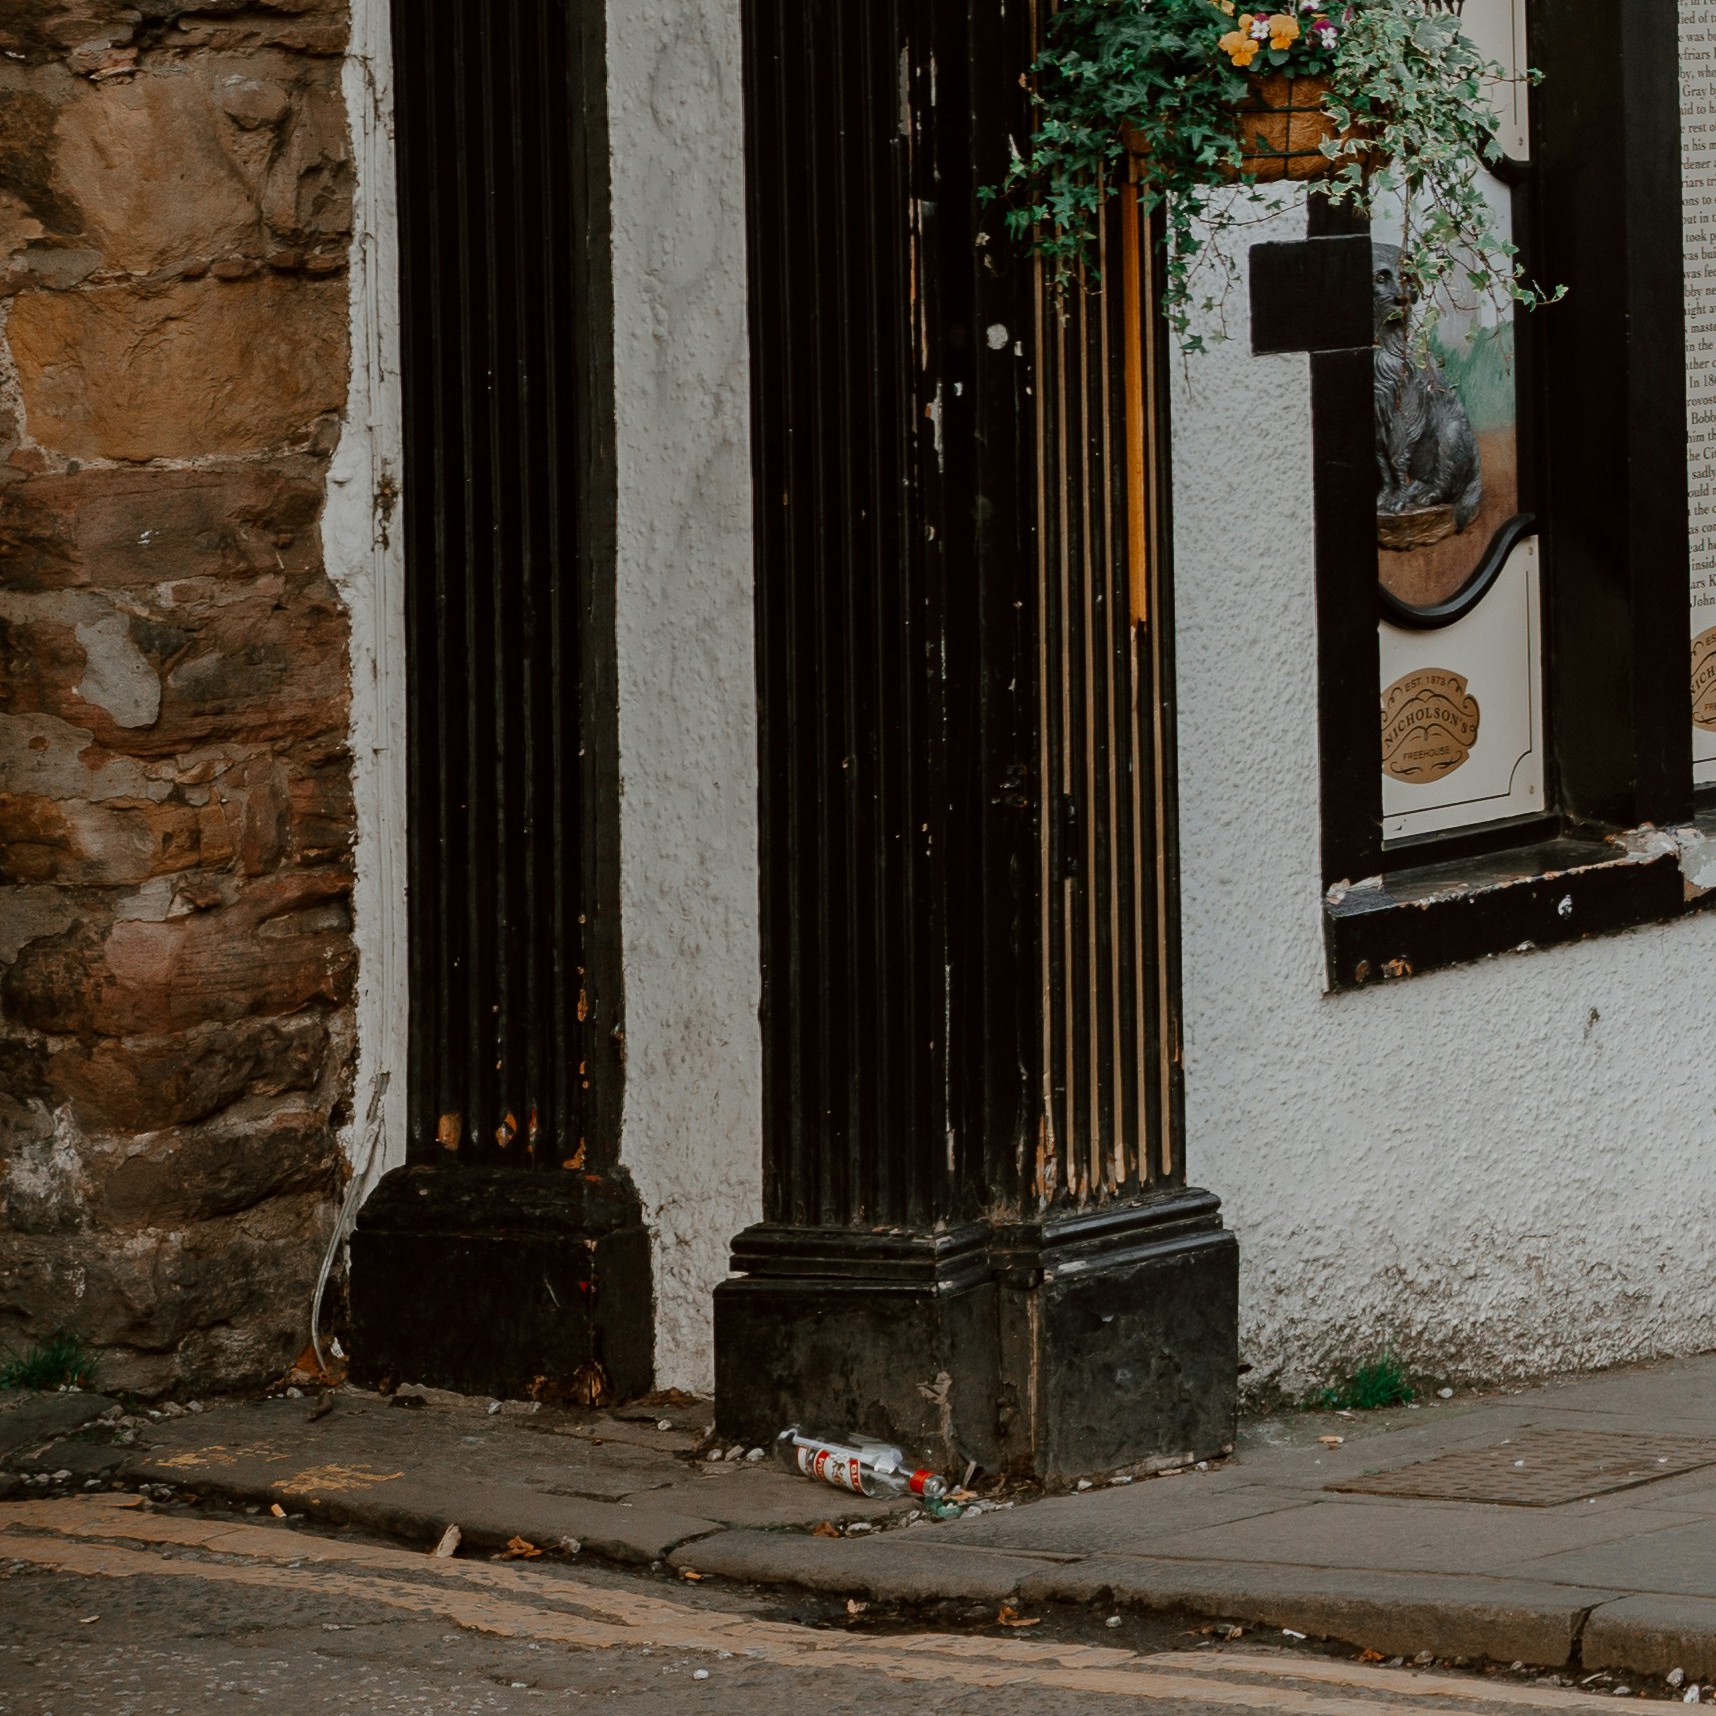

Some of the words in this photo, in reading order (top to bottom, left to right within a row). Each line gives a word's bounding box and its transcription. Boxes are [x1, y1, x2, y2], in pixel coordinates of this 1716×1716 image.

[1698, 10, 1709, 24] of
[1686, 34, 1705, 42] was
[1679, 47, 1711, 61] friars
[1682, 84, 1707, 100] Gray
[1696, 106, 1707, 115] to
[1688, 124, 1707, 133] rest
[1692, 137, 1707, 151] his
[1682, 157, 1710, 170] dener
[1702, 196, 1712, 205] to
[1699, 211, 1709, 224] in
[1685, 228, 1707, 243] took
[1684, 284, 1703, 301] bby
[1685, 302, 1707, 319] ight
[1697, 337, 1714, 351] the
[1689, 375, 1700, 389] In
[1688, 483, 1710, 498] ould
[1694, 501, 1710, 516] the
[1692, 592, 1716, 607] John
[1384, 707, 1468, 749] NICHOLSON'S
